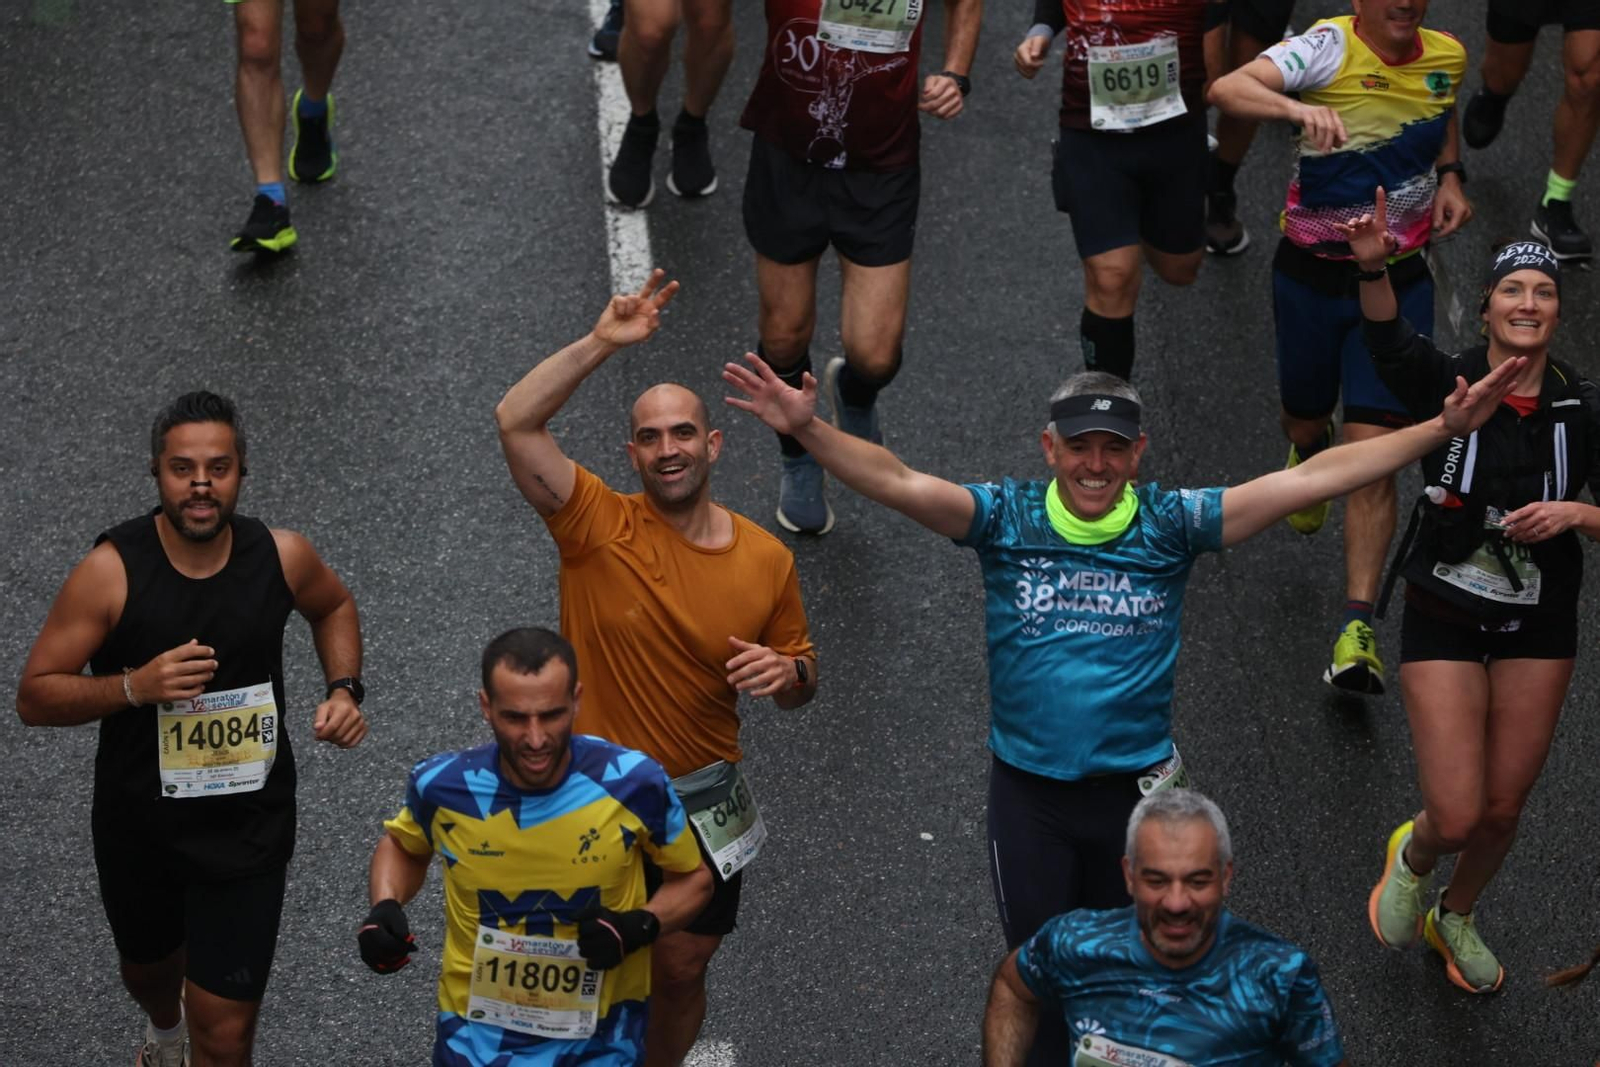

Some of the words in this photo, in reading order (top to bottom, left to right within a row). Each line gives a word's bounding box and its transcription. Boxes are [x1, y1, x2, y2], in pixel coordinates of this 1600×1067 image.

[1103, 63, 1160, 92] 6619
[1493, 243, 1558, 270] SEVILLA
[1513, 254, 1545, 267] 2024
[1058, 570, 1133, 593] MEDIA
[1014, 580, 1055, 613] 38
[170, 713, 260, 752] 14084
[486, 957, 581, 993] 11809
